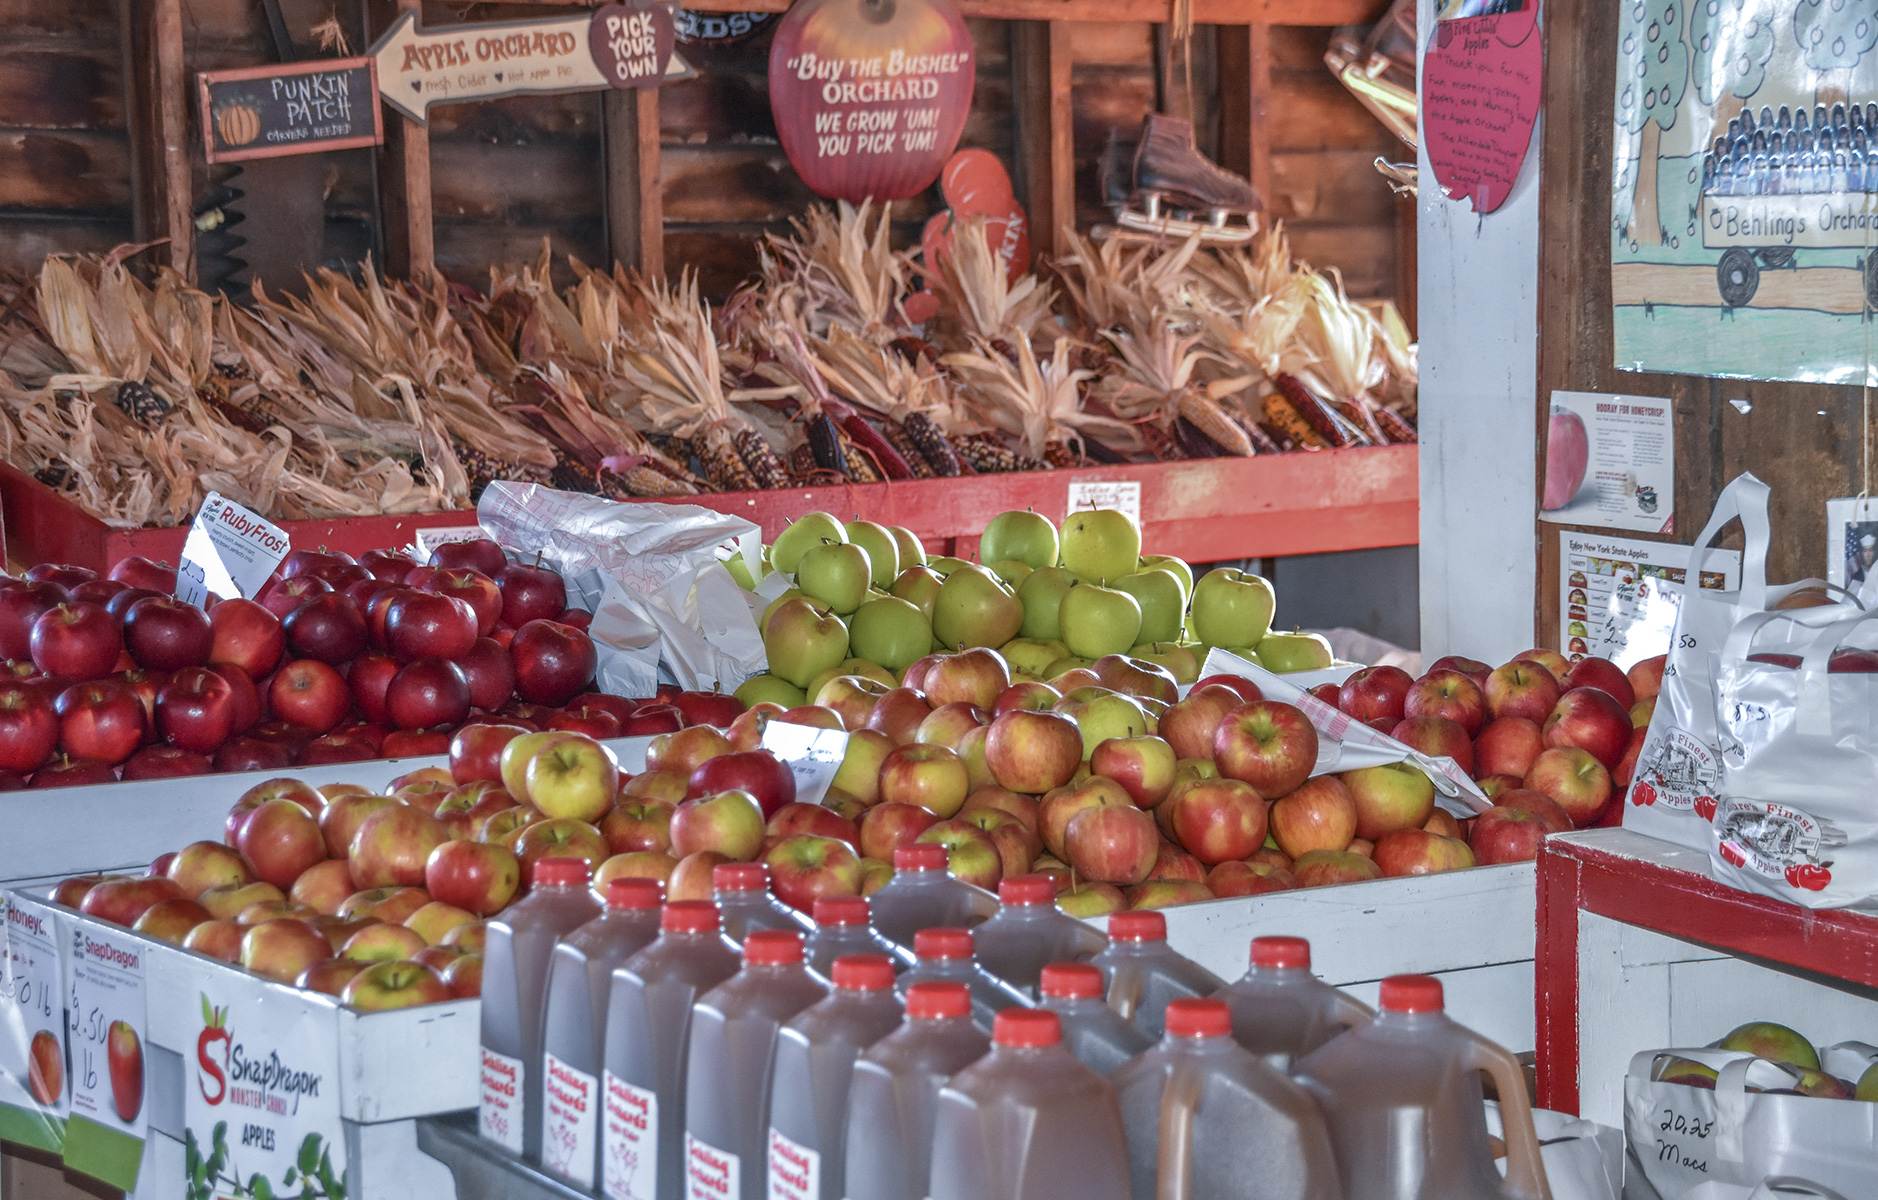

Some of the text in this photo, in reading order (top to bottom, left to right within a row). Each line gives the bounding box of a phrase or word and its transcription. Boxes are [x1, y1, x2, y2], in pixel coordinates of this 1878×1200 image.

[606, 10, 656, 39] PICK
[1454, 21, 1472, 36] Five
[400, 32, 576, 73] APPLE ORCHARD
[608, 36, 656, 60] YOUR
[1463, 38, 1490, 56] Apples
[557, 66, 573, 79] Pie
[616, 55, 658, 80] OWN
[850, 57, 883, 78] THE
[425, 74, 488, 93] Fresh Cider
[822, 78, 939, 104] ORCHARD
[286, 96, 352, 126] PATCH
[815, 108, 941, 134] WE GROW 'UM!
[818, 130, 939, 158] YOU PICK 'UM!
[1619, 404, 1630, 415] FOR
[220, 505, 288, 554] RubyFrost
[1584, 543, 1596, 552] New
[1597, 544, 1611, 554] York
[1612, 545, 1627, 557] State
[1628, 548, 1649, 560] Apples
[1672, 573, 1686, 581] SAUC
[1678, 733, 1711, 765] Finest
[1660, 790, 1692, 807] Apples
[1766, 803, 1815, 833] Finest
[1751, 853, 1781, 874] Apples
[8, 900, 46, 936] Honeyc
[85, 935, 139, 969] SnapDragon
[83, 1048, 98, 1090] lb
[232, 1043, 323, 1117] SnapDragon
[242, 1122, 276, 1152] APPLES
[1657, 1139, 1709, 1173] Macs
